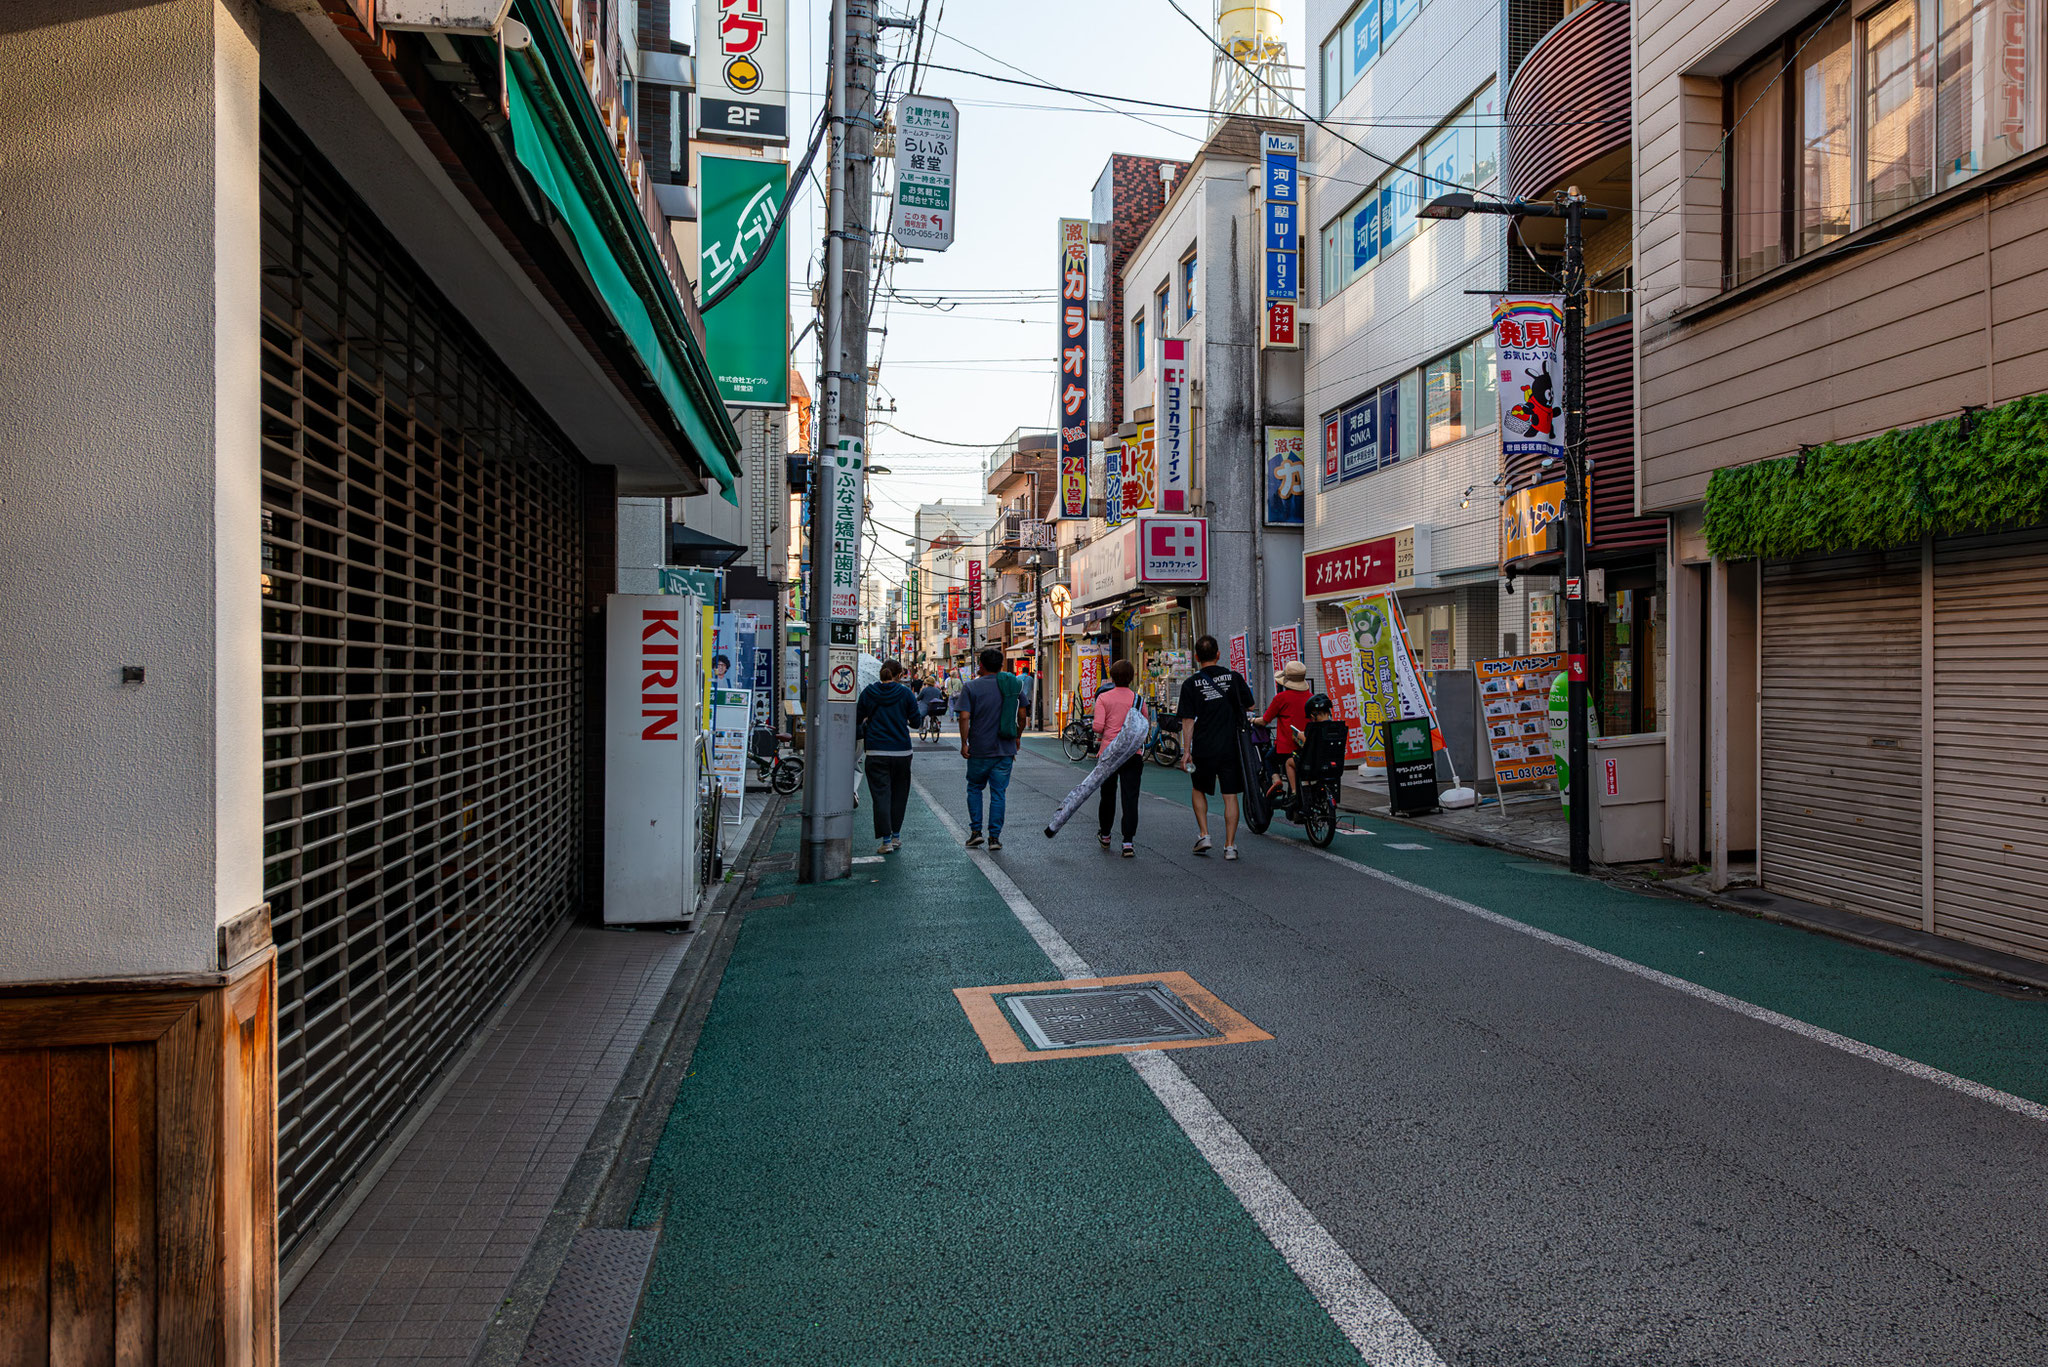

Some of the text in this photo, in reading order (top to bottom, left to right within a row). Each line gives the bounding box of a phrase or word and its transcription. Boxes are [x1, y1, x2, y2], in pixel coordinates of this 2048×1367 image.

[722, 0, 764, 53] ケ
[727, 105, 760, 126] 2F
[905, 106, 950, 119] 介護付有料
[905, 115, 949, 129] 老人ホーム
[902, 129, 952, 141] ホームステーション
[1268, 137, 1295, 150] Mビル
[904, 138, 948, 156] らいふ
[910, 154, 941, 172] 経堂
[904, 212, 928, 222] この先
[897, 227, 949, 240] 0120-055-218
[1273, 168, 1289, 289] 河合塾 wings
[702, 182, 779, 296] エイブル
[1063, 223, 1087, 416] 激安 カラオケ
[718, 376, 769, 385] 株式会社エイブル
[1350, 408, 1371, 431] 河合塾
[1168, 386, 1180, 484] ココカラファイン
[1350, 427, 1371, 447] SINKA
[833, 471, 856, 588] ふなき矯正歯科
[1149, 560, 1198, 568] ココカラファイン
[1316, 555, 1381, 585] メガネストアー
[641, 609, 679, 741] KIRIN
[1482, 655, 1562, 675] タウンハウジング
[1498, 770, 1519, 782] TEL
